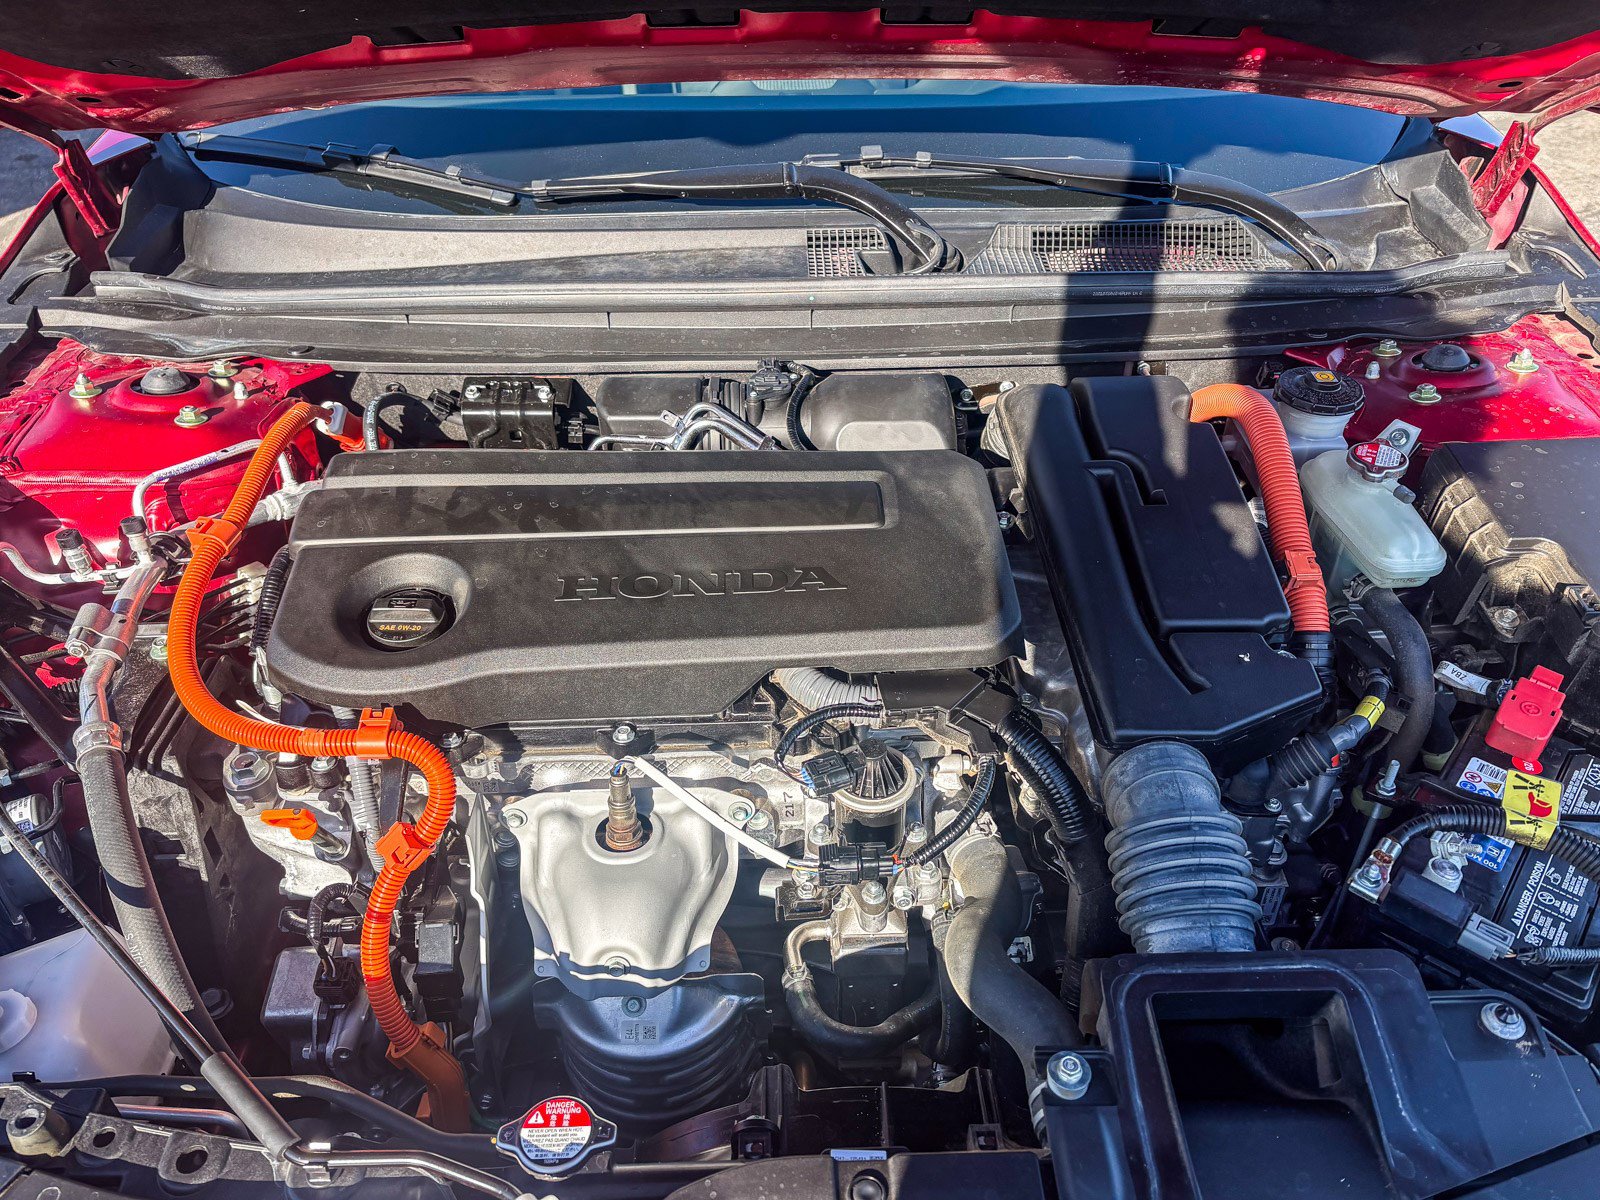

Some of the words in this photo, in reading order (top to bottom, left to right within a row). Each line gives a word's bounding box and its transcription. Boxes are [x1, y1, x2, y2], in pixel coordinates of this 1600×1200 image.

[554, 566, 848, 602] HONDA
[1450, 668, 1468, 682] ZBA
[782, 792, 794, 818] 217
[1483, 860, 1498, 870] 100
[1514, 890, 1534, 919] DANGER
[1528, 861, 1546, 886] POISON
